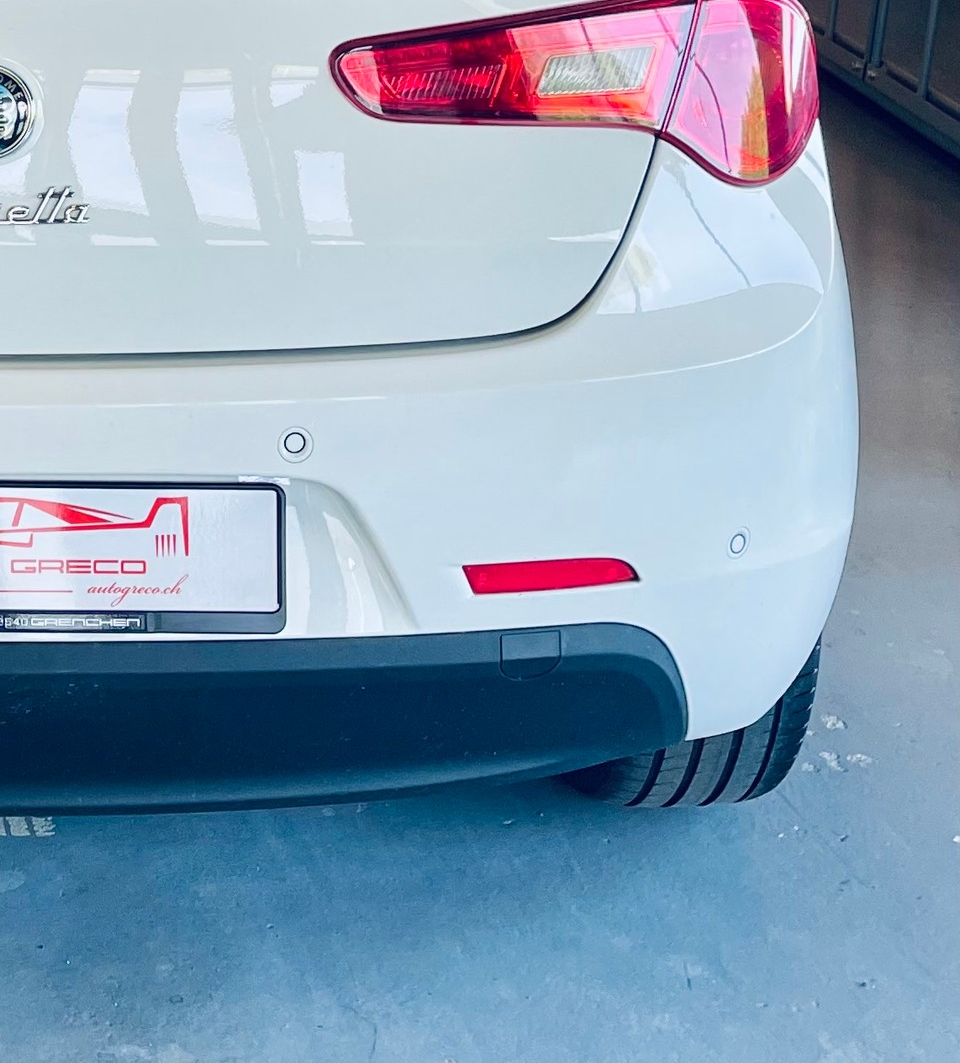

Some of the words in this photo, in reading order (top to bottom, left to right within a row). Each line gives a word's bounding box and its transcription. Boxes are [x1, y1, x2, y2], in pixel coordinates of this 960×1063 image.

[10, 558, 147, 575] GRECO
[87, 574, 190, 608] autogreco.ch
[30, 618, 141, 628] GRENCHEN
